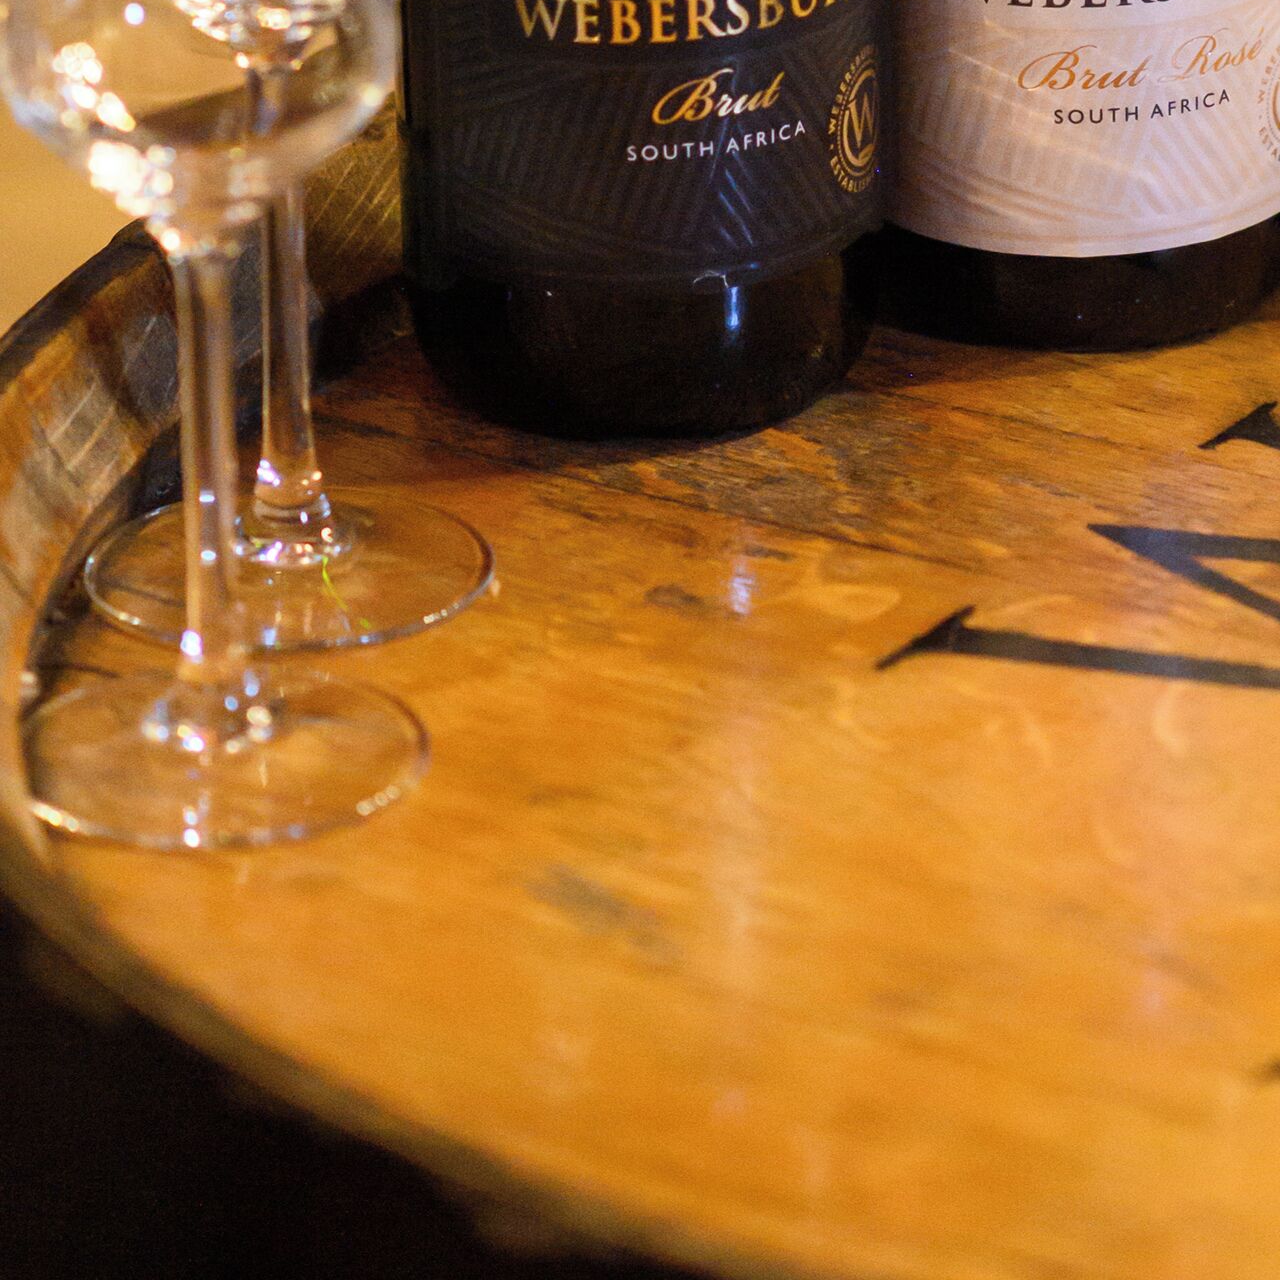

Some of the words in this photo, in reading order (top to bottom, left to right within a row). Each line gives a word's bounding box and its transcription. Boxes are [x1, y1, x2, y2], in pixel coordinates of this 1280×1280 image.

[1017, 44, 1152, 91] Brut
[1157, 27, 1264, 83] Rosé
[651, 68, 785, 125] Brut
[1054, 106, 1138, 125] SOUTH
[1150, 89, 1230, 118] AFRICA
[627, 141, 714, 161] SOUTH
[726, 120, 806, 154] AFRICA
